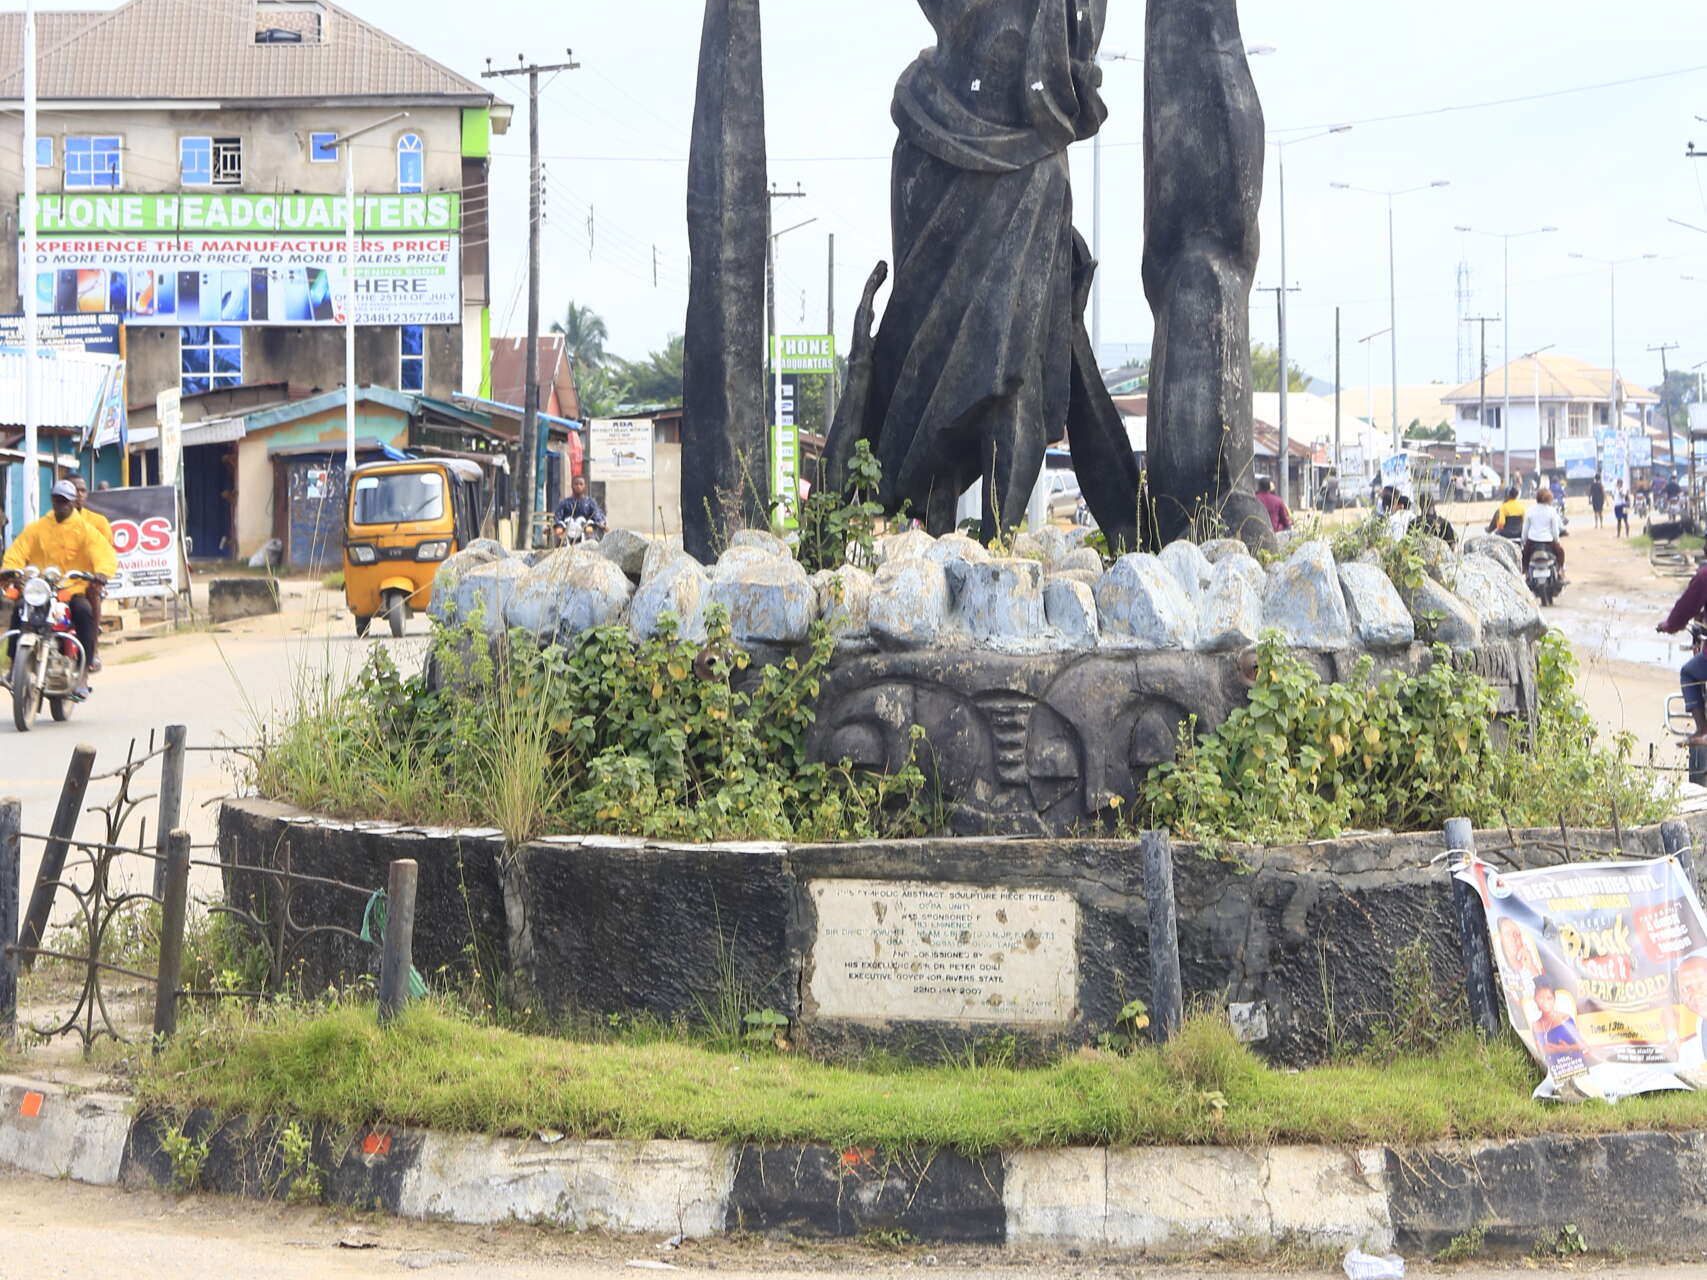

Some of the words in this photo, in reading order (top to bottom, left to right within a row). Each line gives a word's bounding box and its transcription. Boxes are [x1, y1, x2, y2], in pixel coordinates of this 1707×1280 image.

[155, 196, 449, 230] HEADQUARTERS
[22, 241, 147, 253] XPERIENCE
[156, 241, 194, 252] THE
[201, 240, 385, 253] MANUFACTURERS
[393, 240, 450, 252] PRICE
[22, 253, 48, 264] O
[52, 253, 97, 264] MORE
[102, 253, 202, 264] DISTRIBUTOR
[206, 253, 253, 265] PRICE,
[259, 253, 284, 264] NO
[288, 253, 333, 264] MORE
[337, 253, 402, 264] DALERS
[406, 252, 449, 263] PRICE
[353, 278, 428, 294] HERE
[355, 293, 377, 301] THE
[410, 293, 425, 301] OF
[431, 291, 456, 301] JULY
[780, 338, 829, 355] HONE
[771, 358, 833, 370] ADQUARTERS
[118, 558, 168, 569] Available
[902, 890, 944, 899] ABSTRACT
[949, 892, 996, 900] SCULPTURE
[1000, 893, 1025, 901] PIECE
[1028, 894, 1057, 902] TITLED
[921, 913, 973, 921] SPONSORED
[1557, 912, 1632, 960] Break
[844, 961, 859, 969] HIS
[861, 961, 909, 969] EXCELLENC
[949, 963, 976, 971] PETER
[848, 972, 892, 980] EXECUTIVE
[978, 975, 1004, 983] STATE
[913, 985, 937, 993] 22ND
